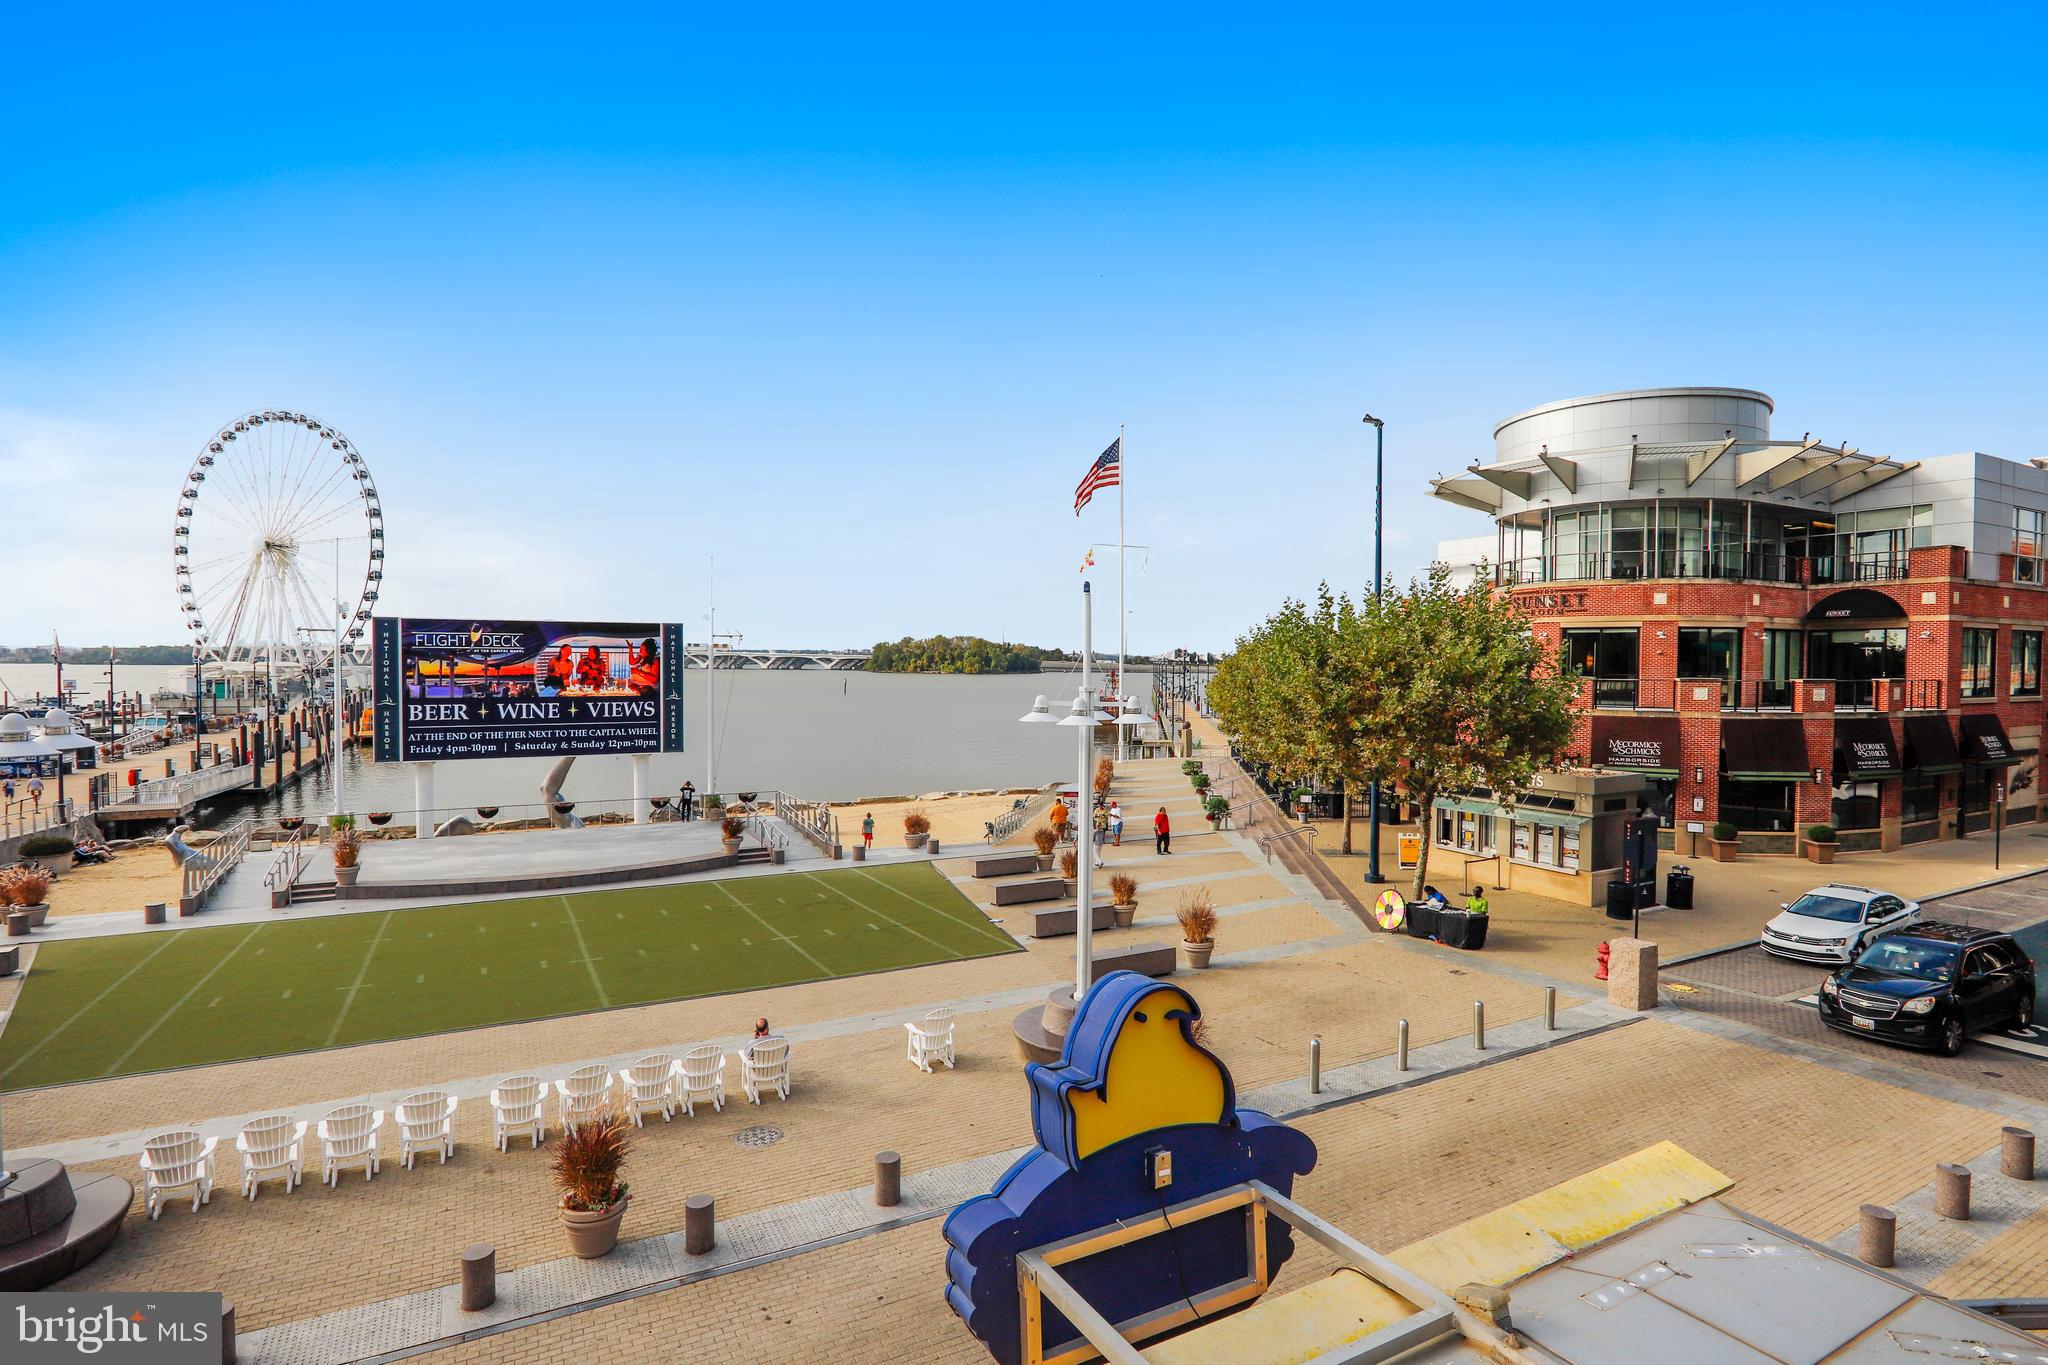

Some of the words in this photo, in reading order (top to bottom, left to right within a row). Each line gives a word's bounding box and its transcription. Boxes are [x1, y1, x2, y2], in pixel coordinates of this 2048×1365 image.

[1514, 593, 1588, 609] SUNSET
[415, 634, 469, 646] FLIGHT
[482, 635, 520, 647] DECK
[408, 704, 469, 721] BEER
[497, 703, 560, 719] WINE
[586, 701, 656, 717] VIEWS
[408, 733, 422, 741] AT
[424, 732, 444, 741] THE
[446, 732, 467, 740] END
[470, 731, 483, 739] OF
[484, 731, 504, 739] THE
[528, 730, 552, 738] NEXT
[554, 729, 567, 737] TO
[589, 728, 627, 736] CAPITAL
[628, 727, 658, 735] WHEEL
[410, 745, 443, 754] Friday
[446, 743, 497, 754] 4pm-10pm
[514, 742, 557, 751] Saturday
[560, 741, 569, 749] &
[571, 740, 605, 749] Sunday
[608, 739, 657, 749] 12pm-10pm
